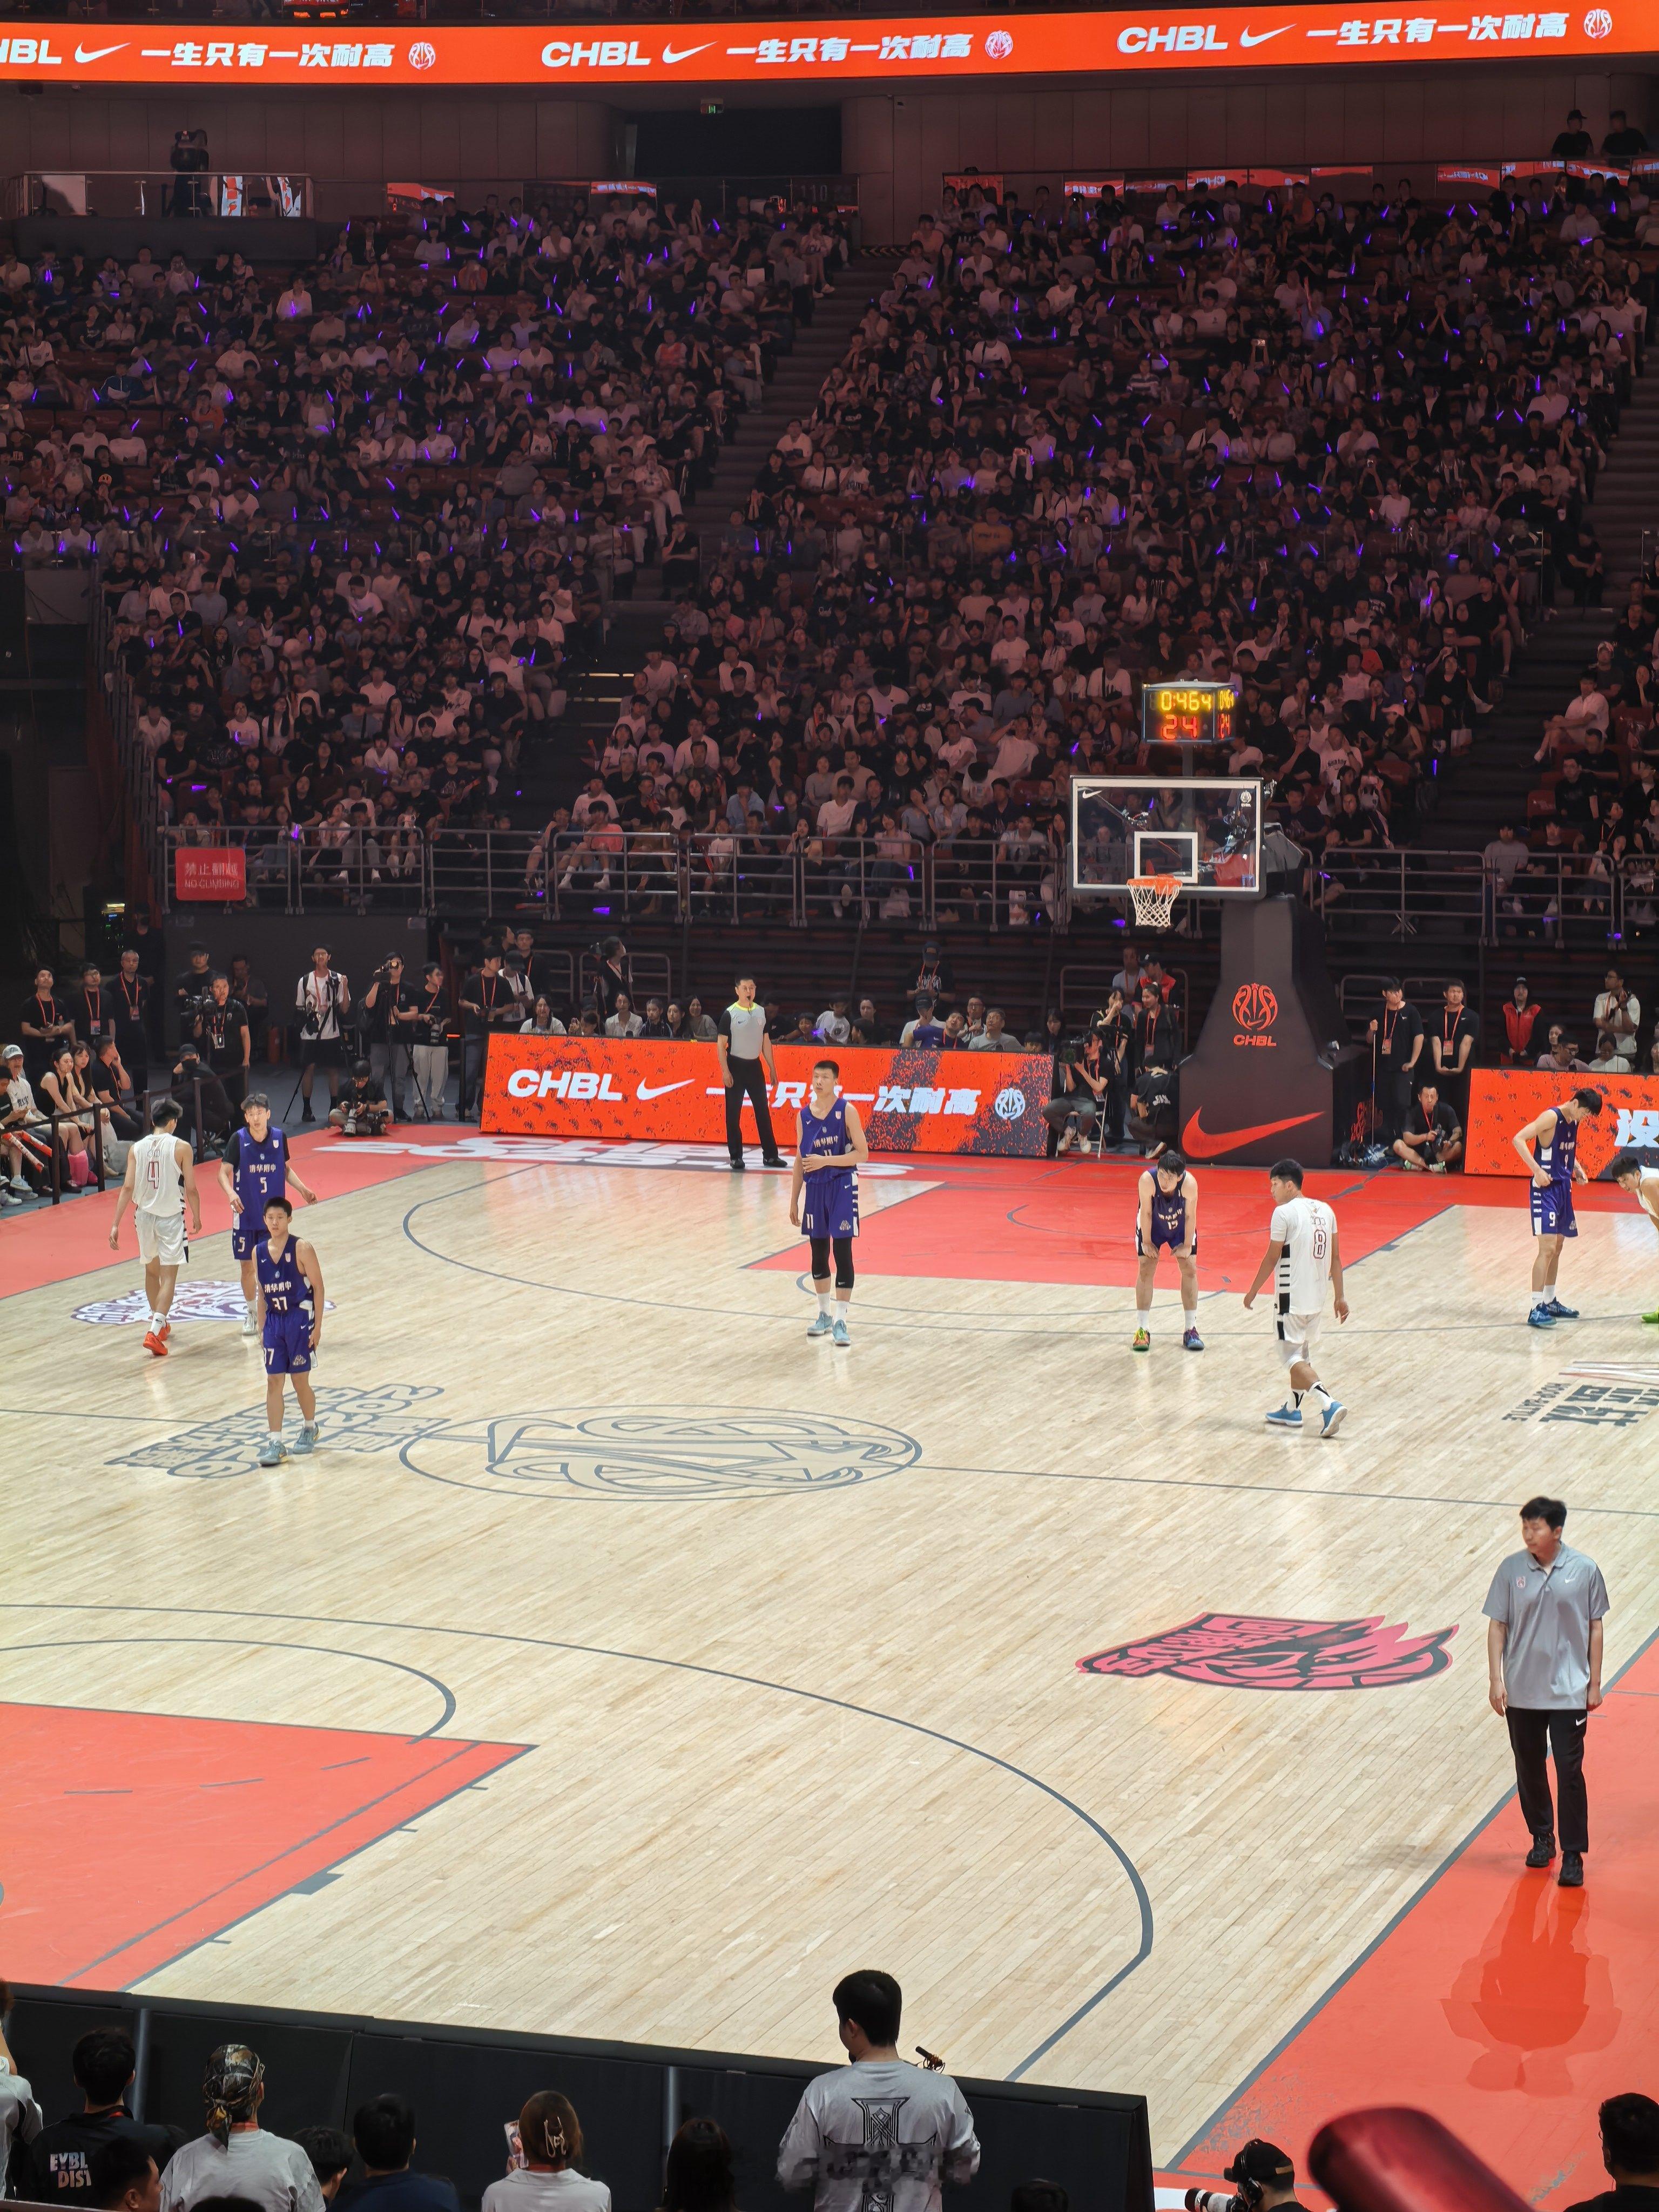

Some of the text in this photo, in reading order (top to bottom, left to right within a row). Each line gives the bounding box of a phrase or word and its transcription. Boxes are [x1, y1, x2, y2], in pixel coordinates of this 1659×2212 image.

[1117, 25, 1229, 53] CHBL
[1306, 12, 1569, 45] 一生只有一次耐高
[141, 42, 395, 67] 一生只有一次耐高
[541, 41, 651, 67] CHBL
[726, 33, 974, 63] 一生只有一次耐高
[1162, 714, 1197, 740] 24
[1233, 1034, 1277, 1047] CHBL
[508, 1069, 623, 1101] CHBL
[260, 1177, 267, 1193] 5
[1549, 1211, 1556, 1226] 9
[237, 1237, 246, 1252] 5
[1313, 1229, 1327, 1259] 8
[272, 1296, 288, 1311] 37
[50, 2152, 88, 2171] EYBL
